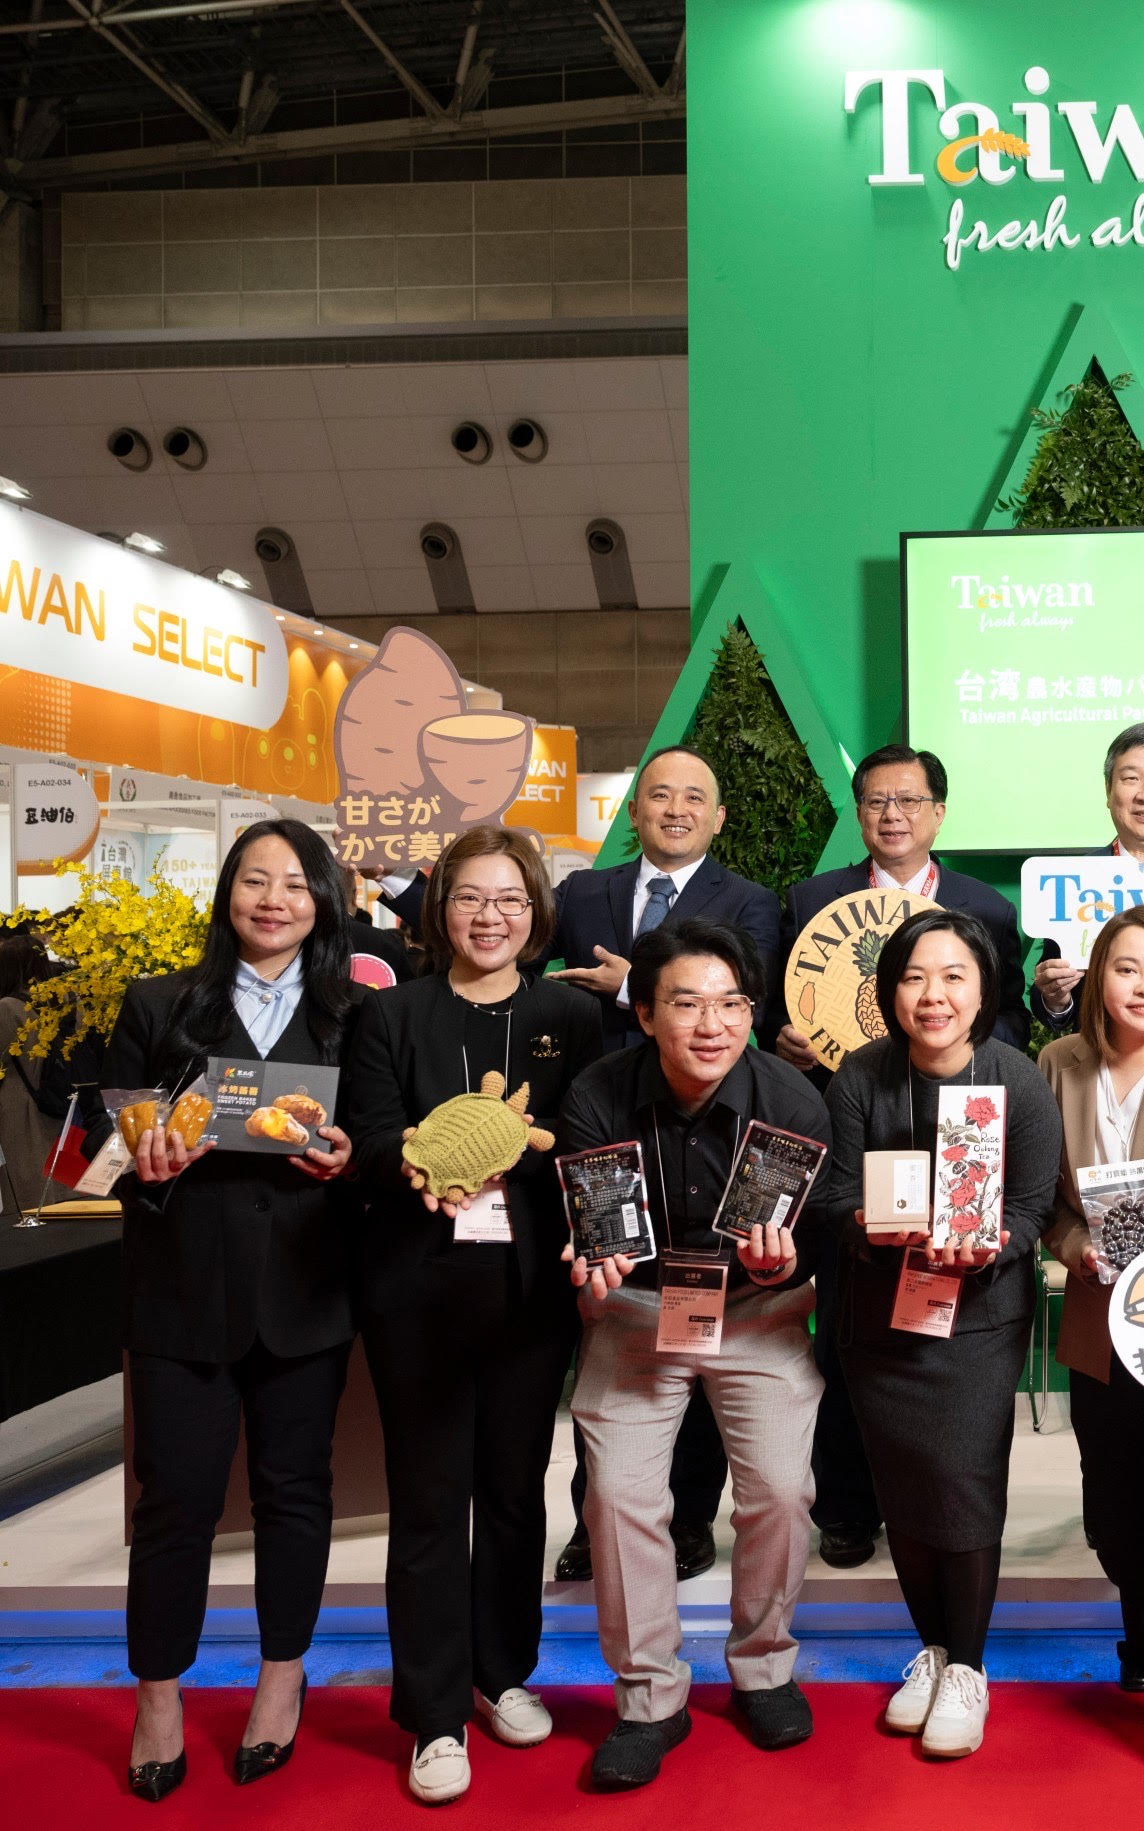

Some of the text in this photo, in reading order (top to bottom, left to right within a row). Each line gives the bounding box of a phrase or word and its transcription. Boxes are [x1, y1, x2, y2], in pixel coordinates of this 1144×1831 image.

[943, 195, 1080, 269] fresh
[951, 575, 1095, 609] Taiwan
[0, 559, 266, 689] WAN SELECT
[978, 611, 1074, 632] fresh always
[960, 708, 1016, 724] Taiwan
[1020, 704, 1118, 726] Agricultural
[28, 779, 71, 787] E5-A02-034
[340, 795, 440, 826] 甘さが
[340, 831, 457, 862] かで美
[794, 895, 911, 978] TAIWA
[981, 1131, 1000, 1143] Rose
